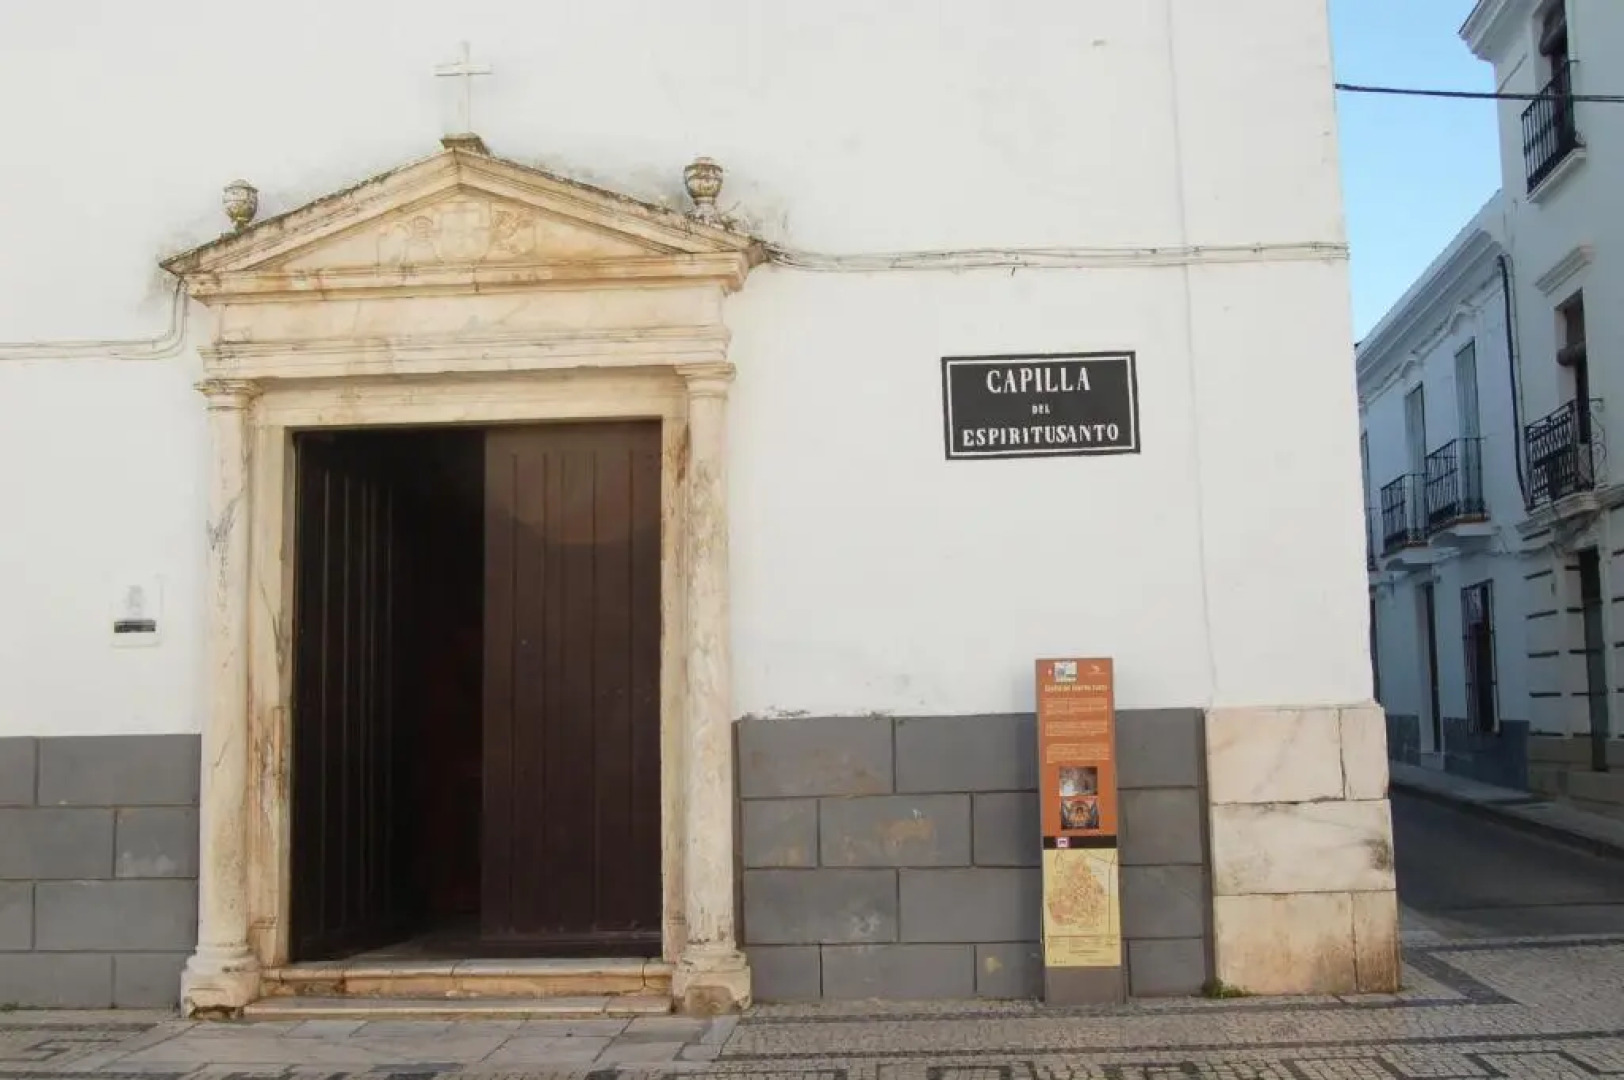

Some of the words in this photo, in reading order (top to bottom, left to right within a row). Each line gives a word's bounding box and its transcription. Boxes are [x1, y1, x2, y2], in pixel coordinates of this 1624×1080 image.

[986, 366, 1091, 393] CAPILLA
[1032, 403, 1050, 414] DEL
[962, 423, 1119, 447] ESPIRITUSANTO
